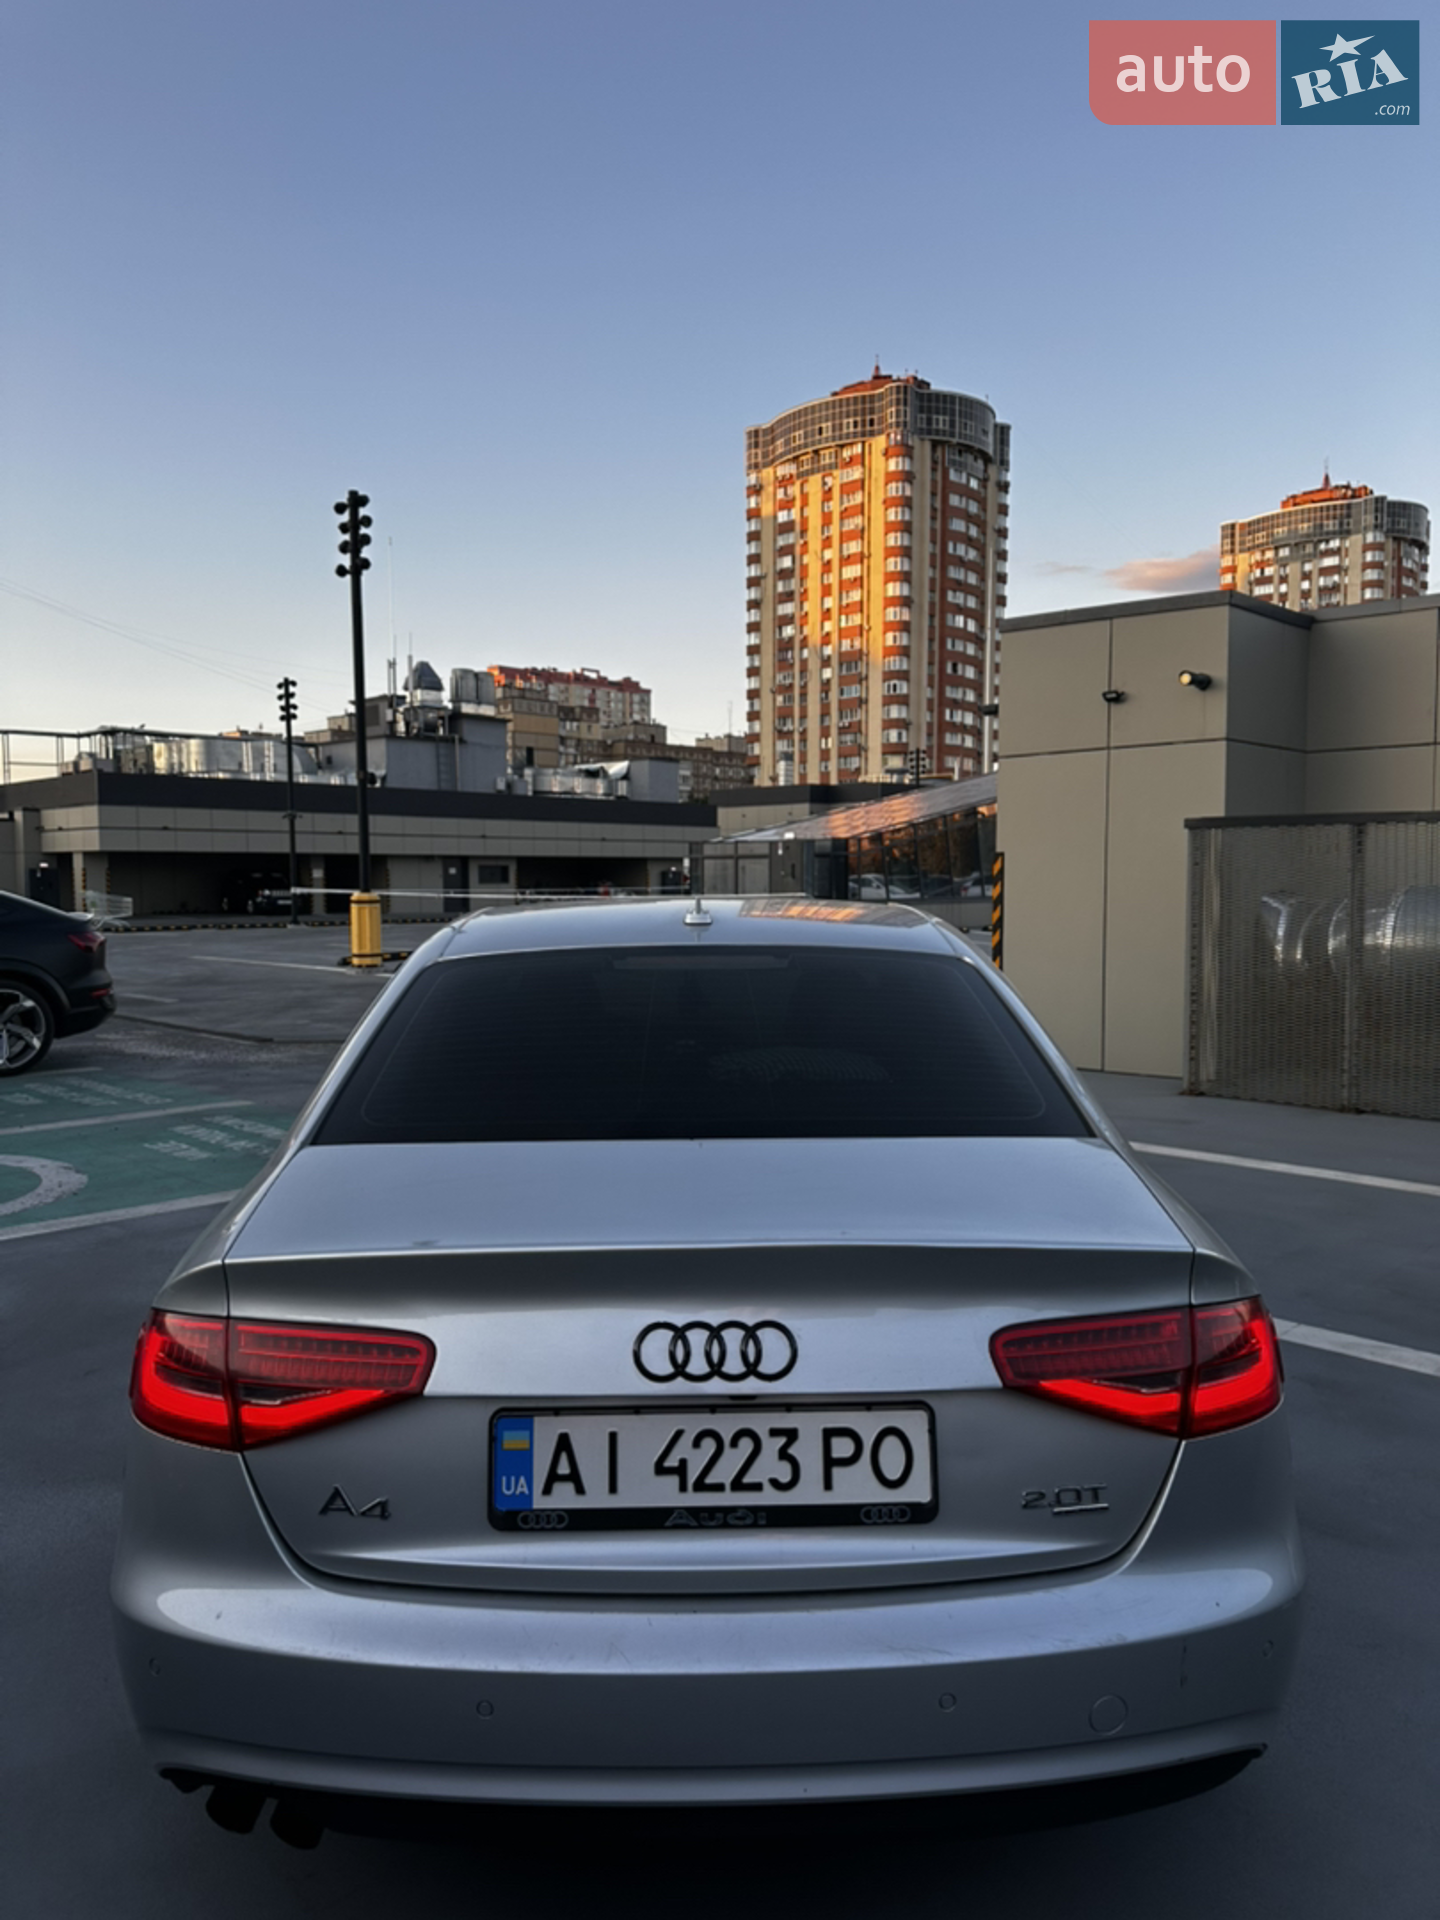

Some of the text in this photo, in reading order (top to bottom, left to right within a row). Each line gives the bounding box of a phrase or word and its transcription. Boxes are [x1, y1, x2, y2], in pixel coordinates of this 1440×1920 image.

[541, 1425, 914, 1496] AI 4223 PO
[501, 1476, 529, 1496] UA
[1021, 1483, 1108, 1509] 2.0T
[318, 1484, 391, 1520] A4
